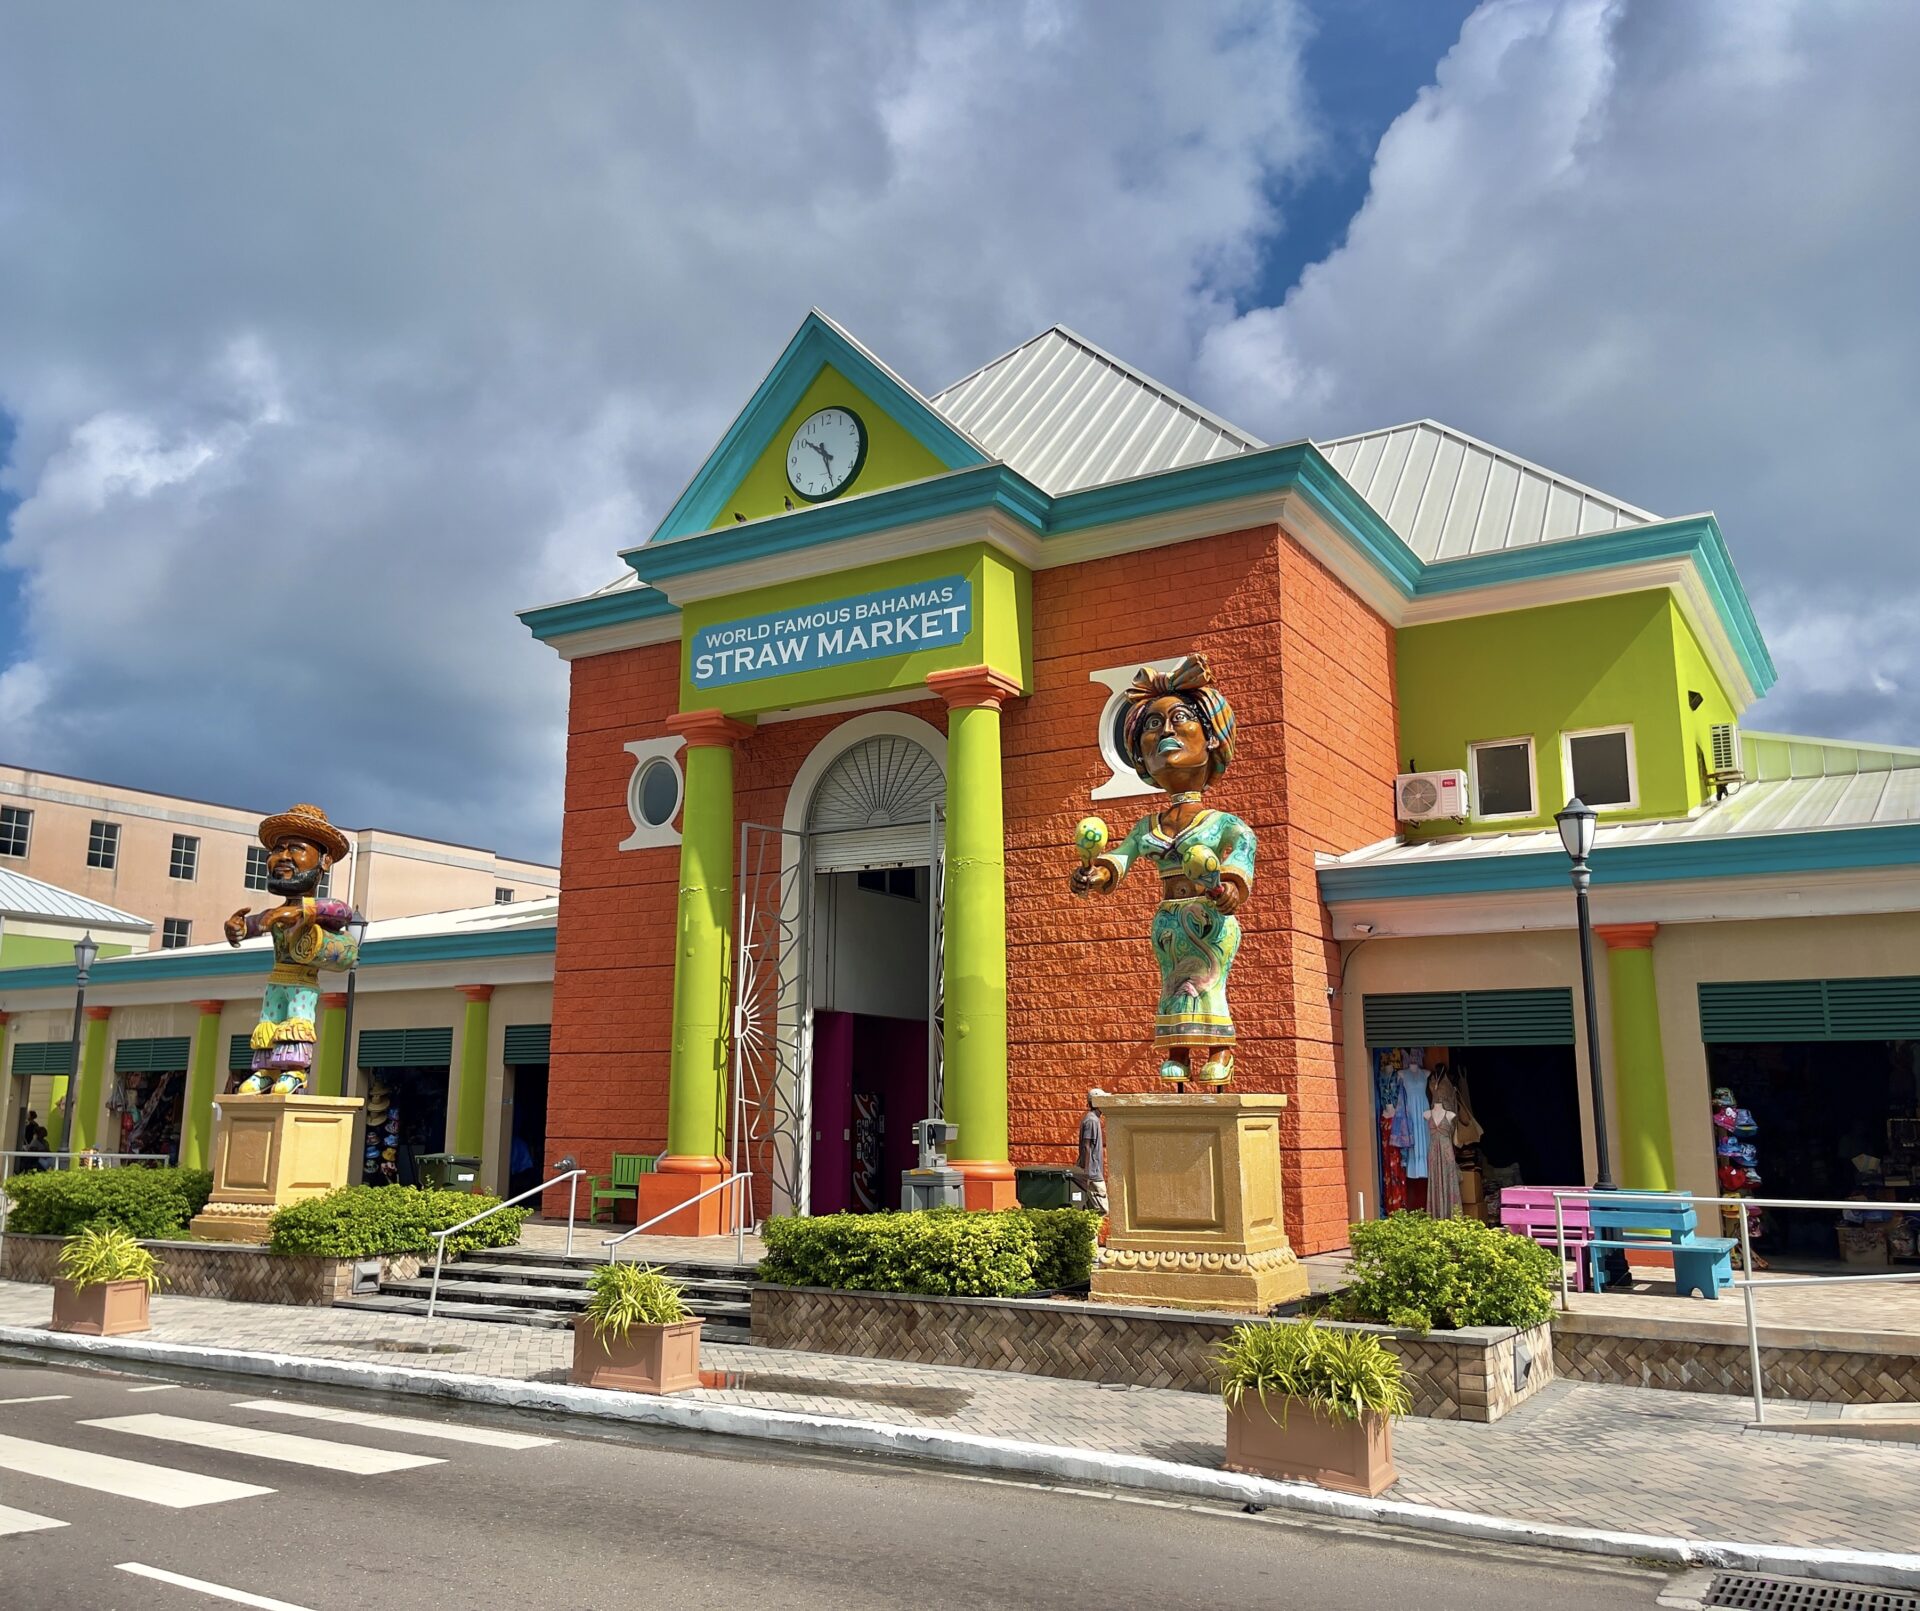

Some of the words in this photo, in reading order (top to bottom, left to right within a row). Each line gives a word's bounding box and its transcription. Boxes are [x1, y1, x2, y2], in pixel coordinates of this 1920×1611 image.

[820, 414, 831, 426] 12
[807, 423, 816, 435] 11
[849, 424, 855, 436] 2
[796, 438, 808, 450] 10
[791, 456, 797, 467] 9
[848, 460, 854, 469] 4
[795, 472, 801, 483] 8
[808, 482, 813, 493] 7
[821, 483, 827, 493] 6
[706, 623, 771, 649] WORLD
[774, 607, 851, 635] FAMOUS
[855, 587, 954, 620] BAHAMAS
[695, 635, 810, 680] STRAW
[817, 604, 966, 658] MARKET
